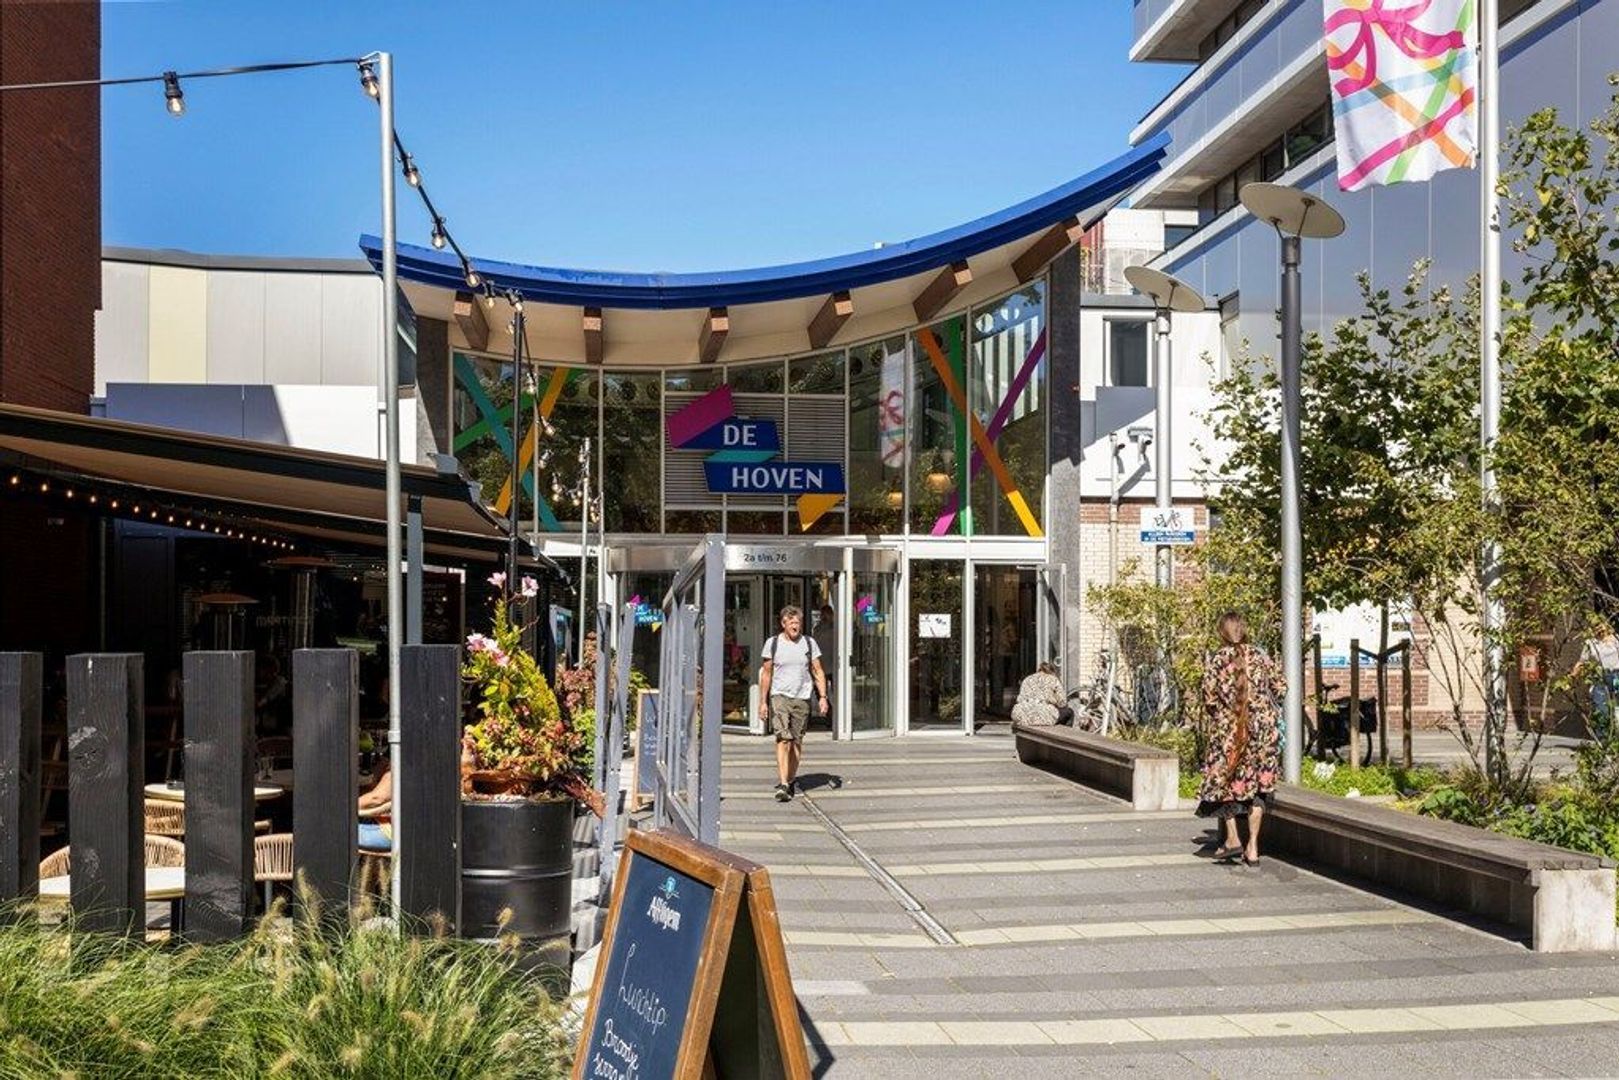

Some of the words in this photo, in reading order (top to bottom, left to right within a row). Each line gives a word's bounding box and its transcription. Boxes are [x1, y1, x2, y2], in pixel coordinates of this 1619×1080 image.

[723, 424, 757, 446] DE
[732, 467, 823, 489] HOVEN
[743, 553, 756, 563] 2a
[776, 553, 788, 563] 76
